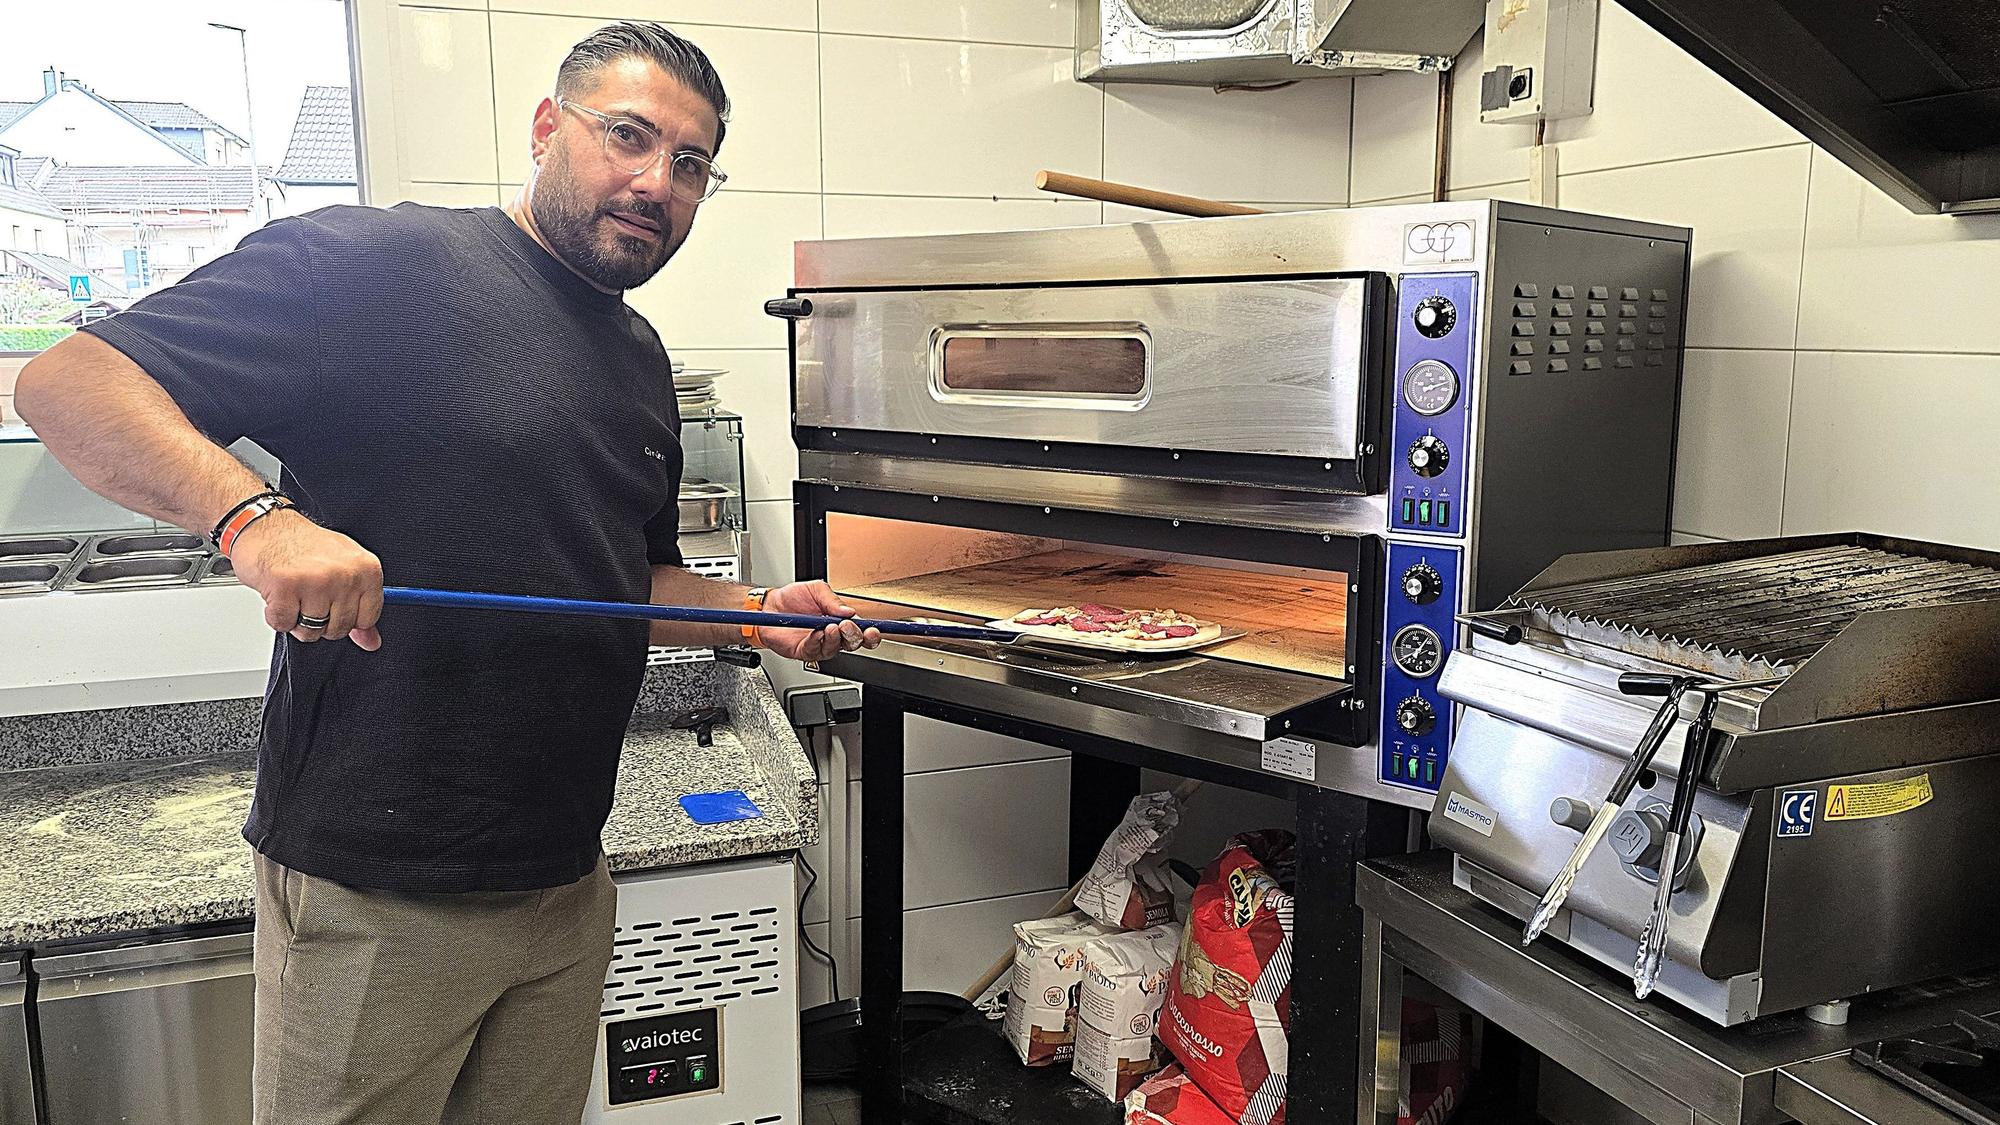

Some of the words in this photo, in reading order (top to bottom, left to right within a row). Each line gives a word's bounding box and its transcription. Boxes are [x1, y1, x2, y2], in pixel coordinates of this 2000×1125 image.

[1458, 804, 1492, 826] MASTRO
[1783, 794, 1815, 825] CE
[1786, 825, 1804, 834] 2195
[629, 1028, 703, 1052] vaiotec
